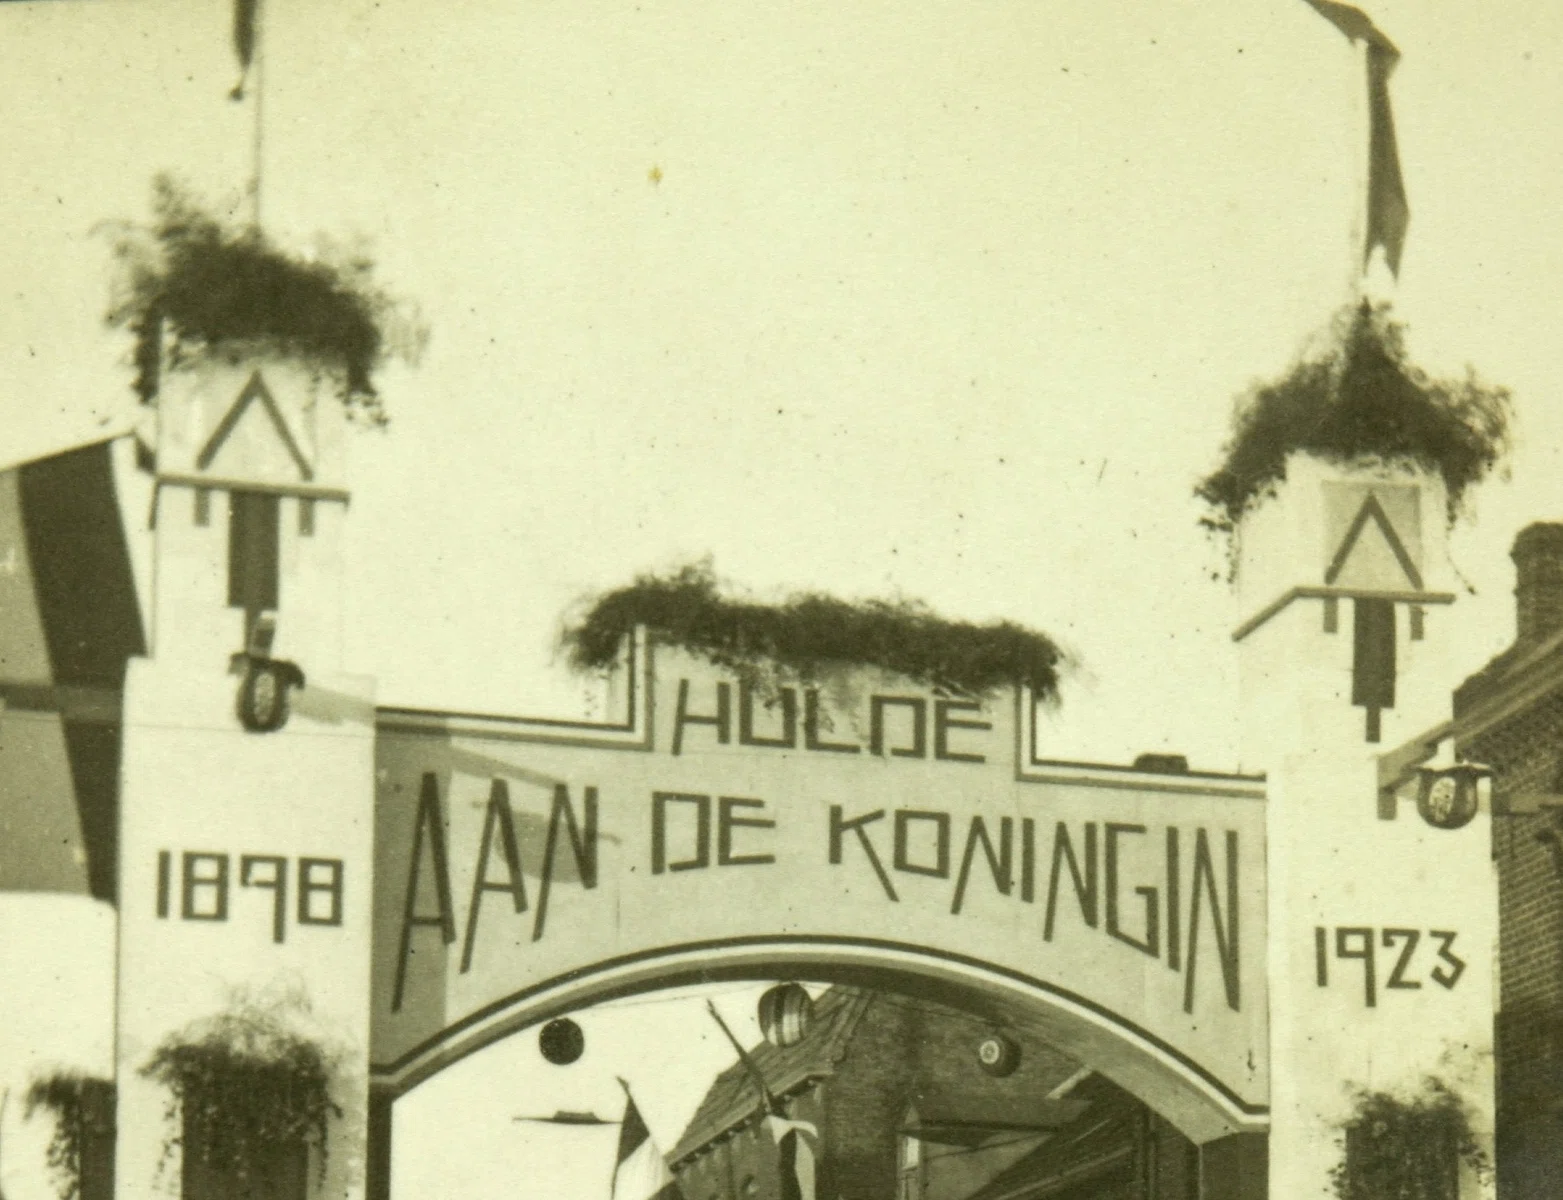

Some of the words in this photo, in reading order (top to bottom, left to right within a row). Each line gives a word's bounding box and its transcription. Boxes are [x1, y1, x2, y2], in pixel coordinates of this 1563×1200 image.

[672, 678, 993, 764] HULDE
[157, 850, 344, 944] 1898
[391, 772, 600, 1013] AAN
[651, 791, 777, 876] DE
[829, 805, 1241, 1015] KONINGIN
[1315, 926, 1467, 1008] 1923
